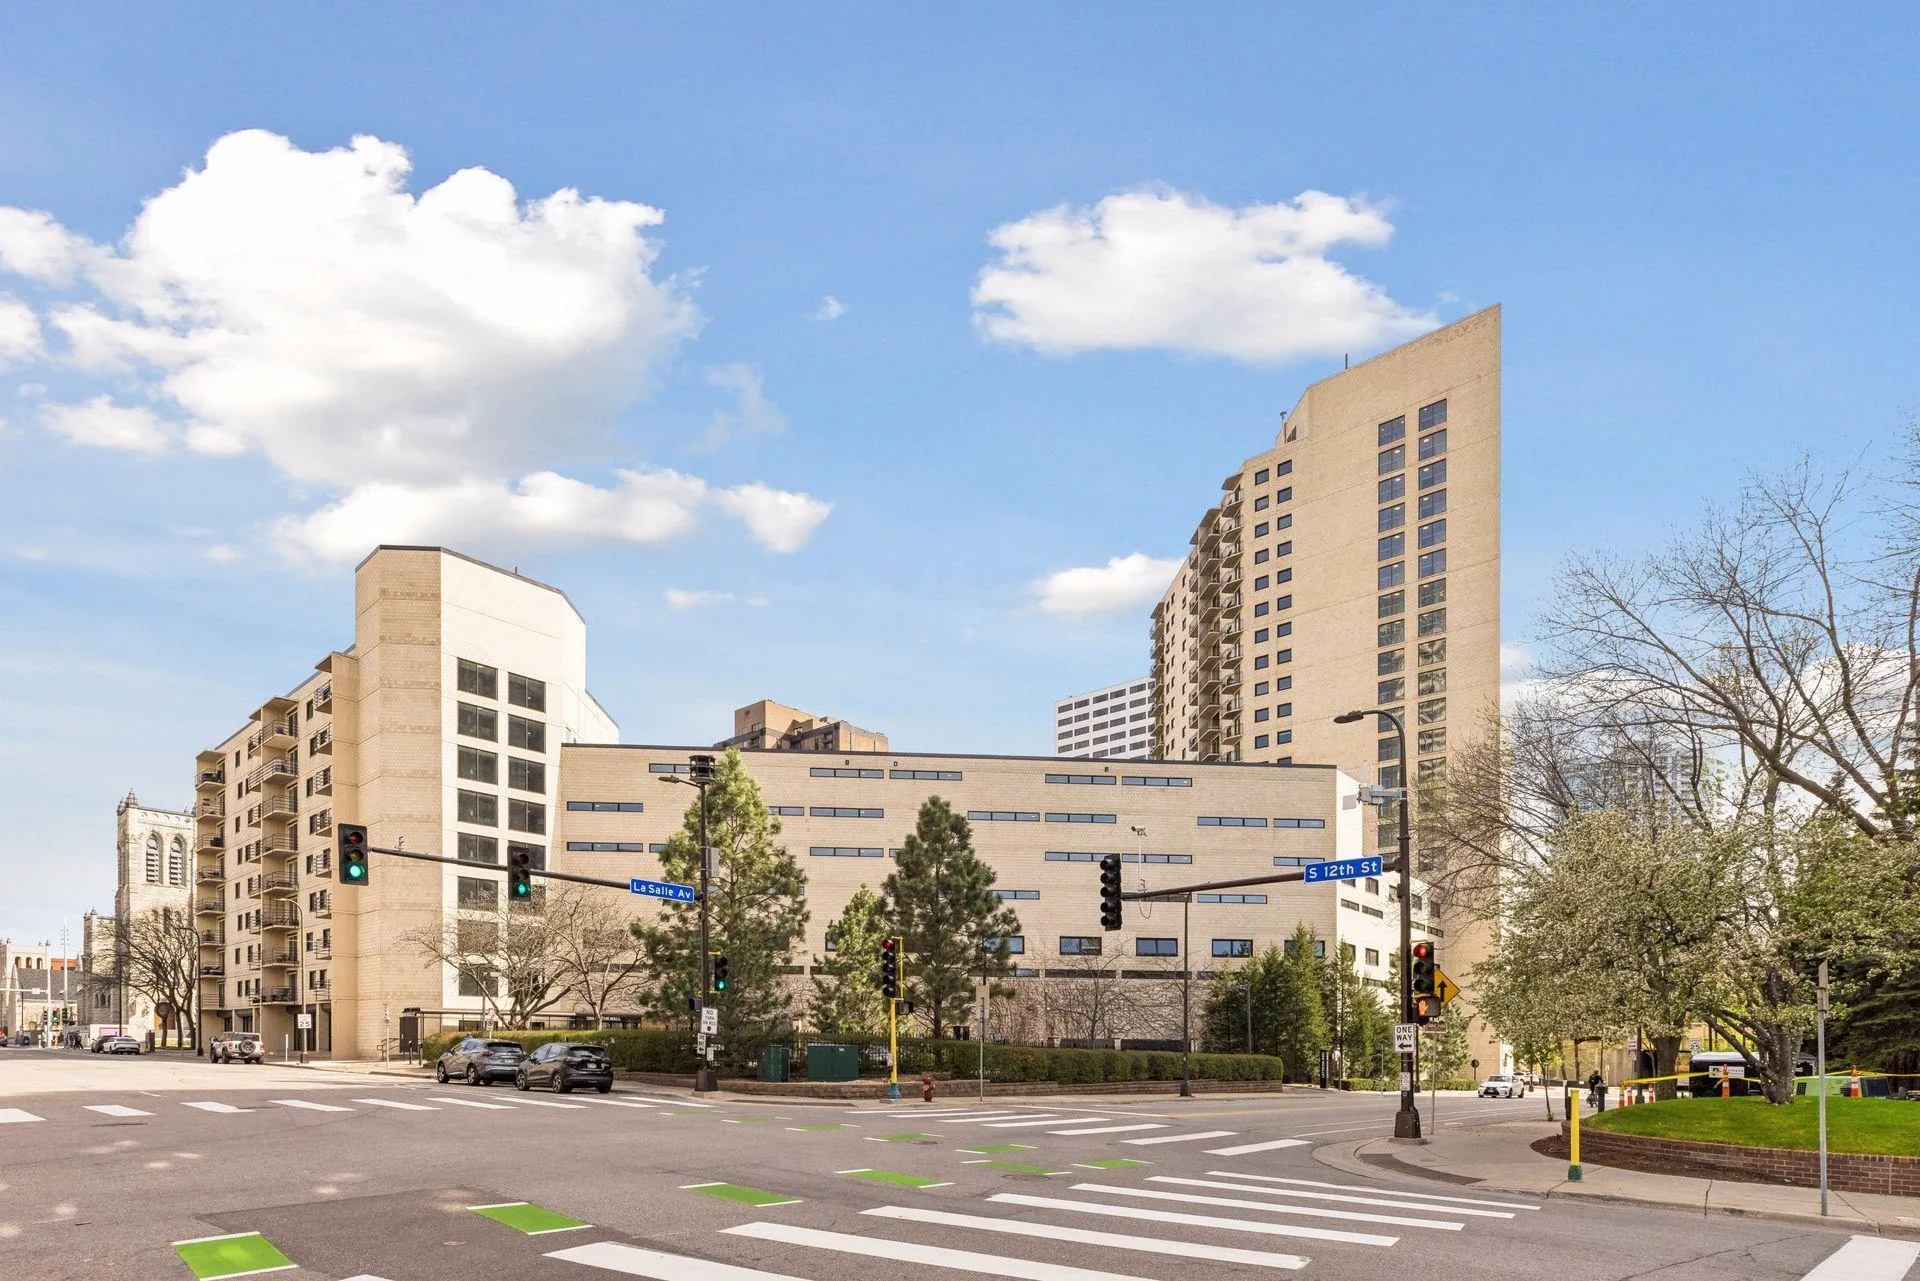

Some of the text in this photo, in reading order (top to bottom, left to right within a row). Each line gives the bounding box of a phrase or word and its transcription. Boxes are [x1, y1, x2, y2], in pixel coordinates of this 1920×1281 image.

[1309, 861, 1377, 879] S 12th St
[677, 889, 691, 899] Av
